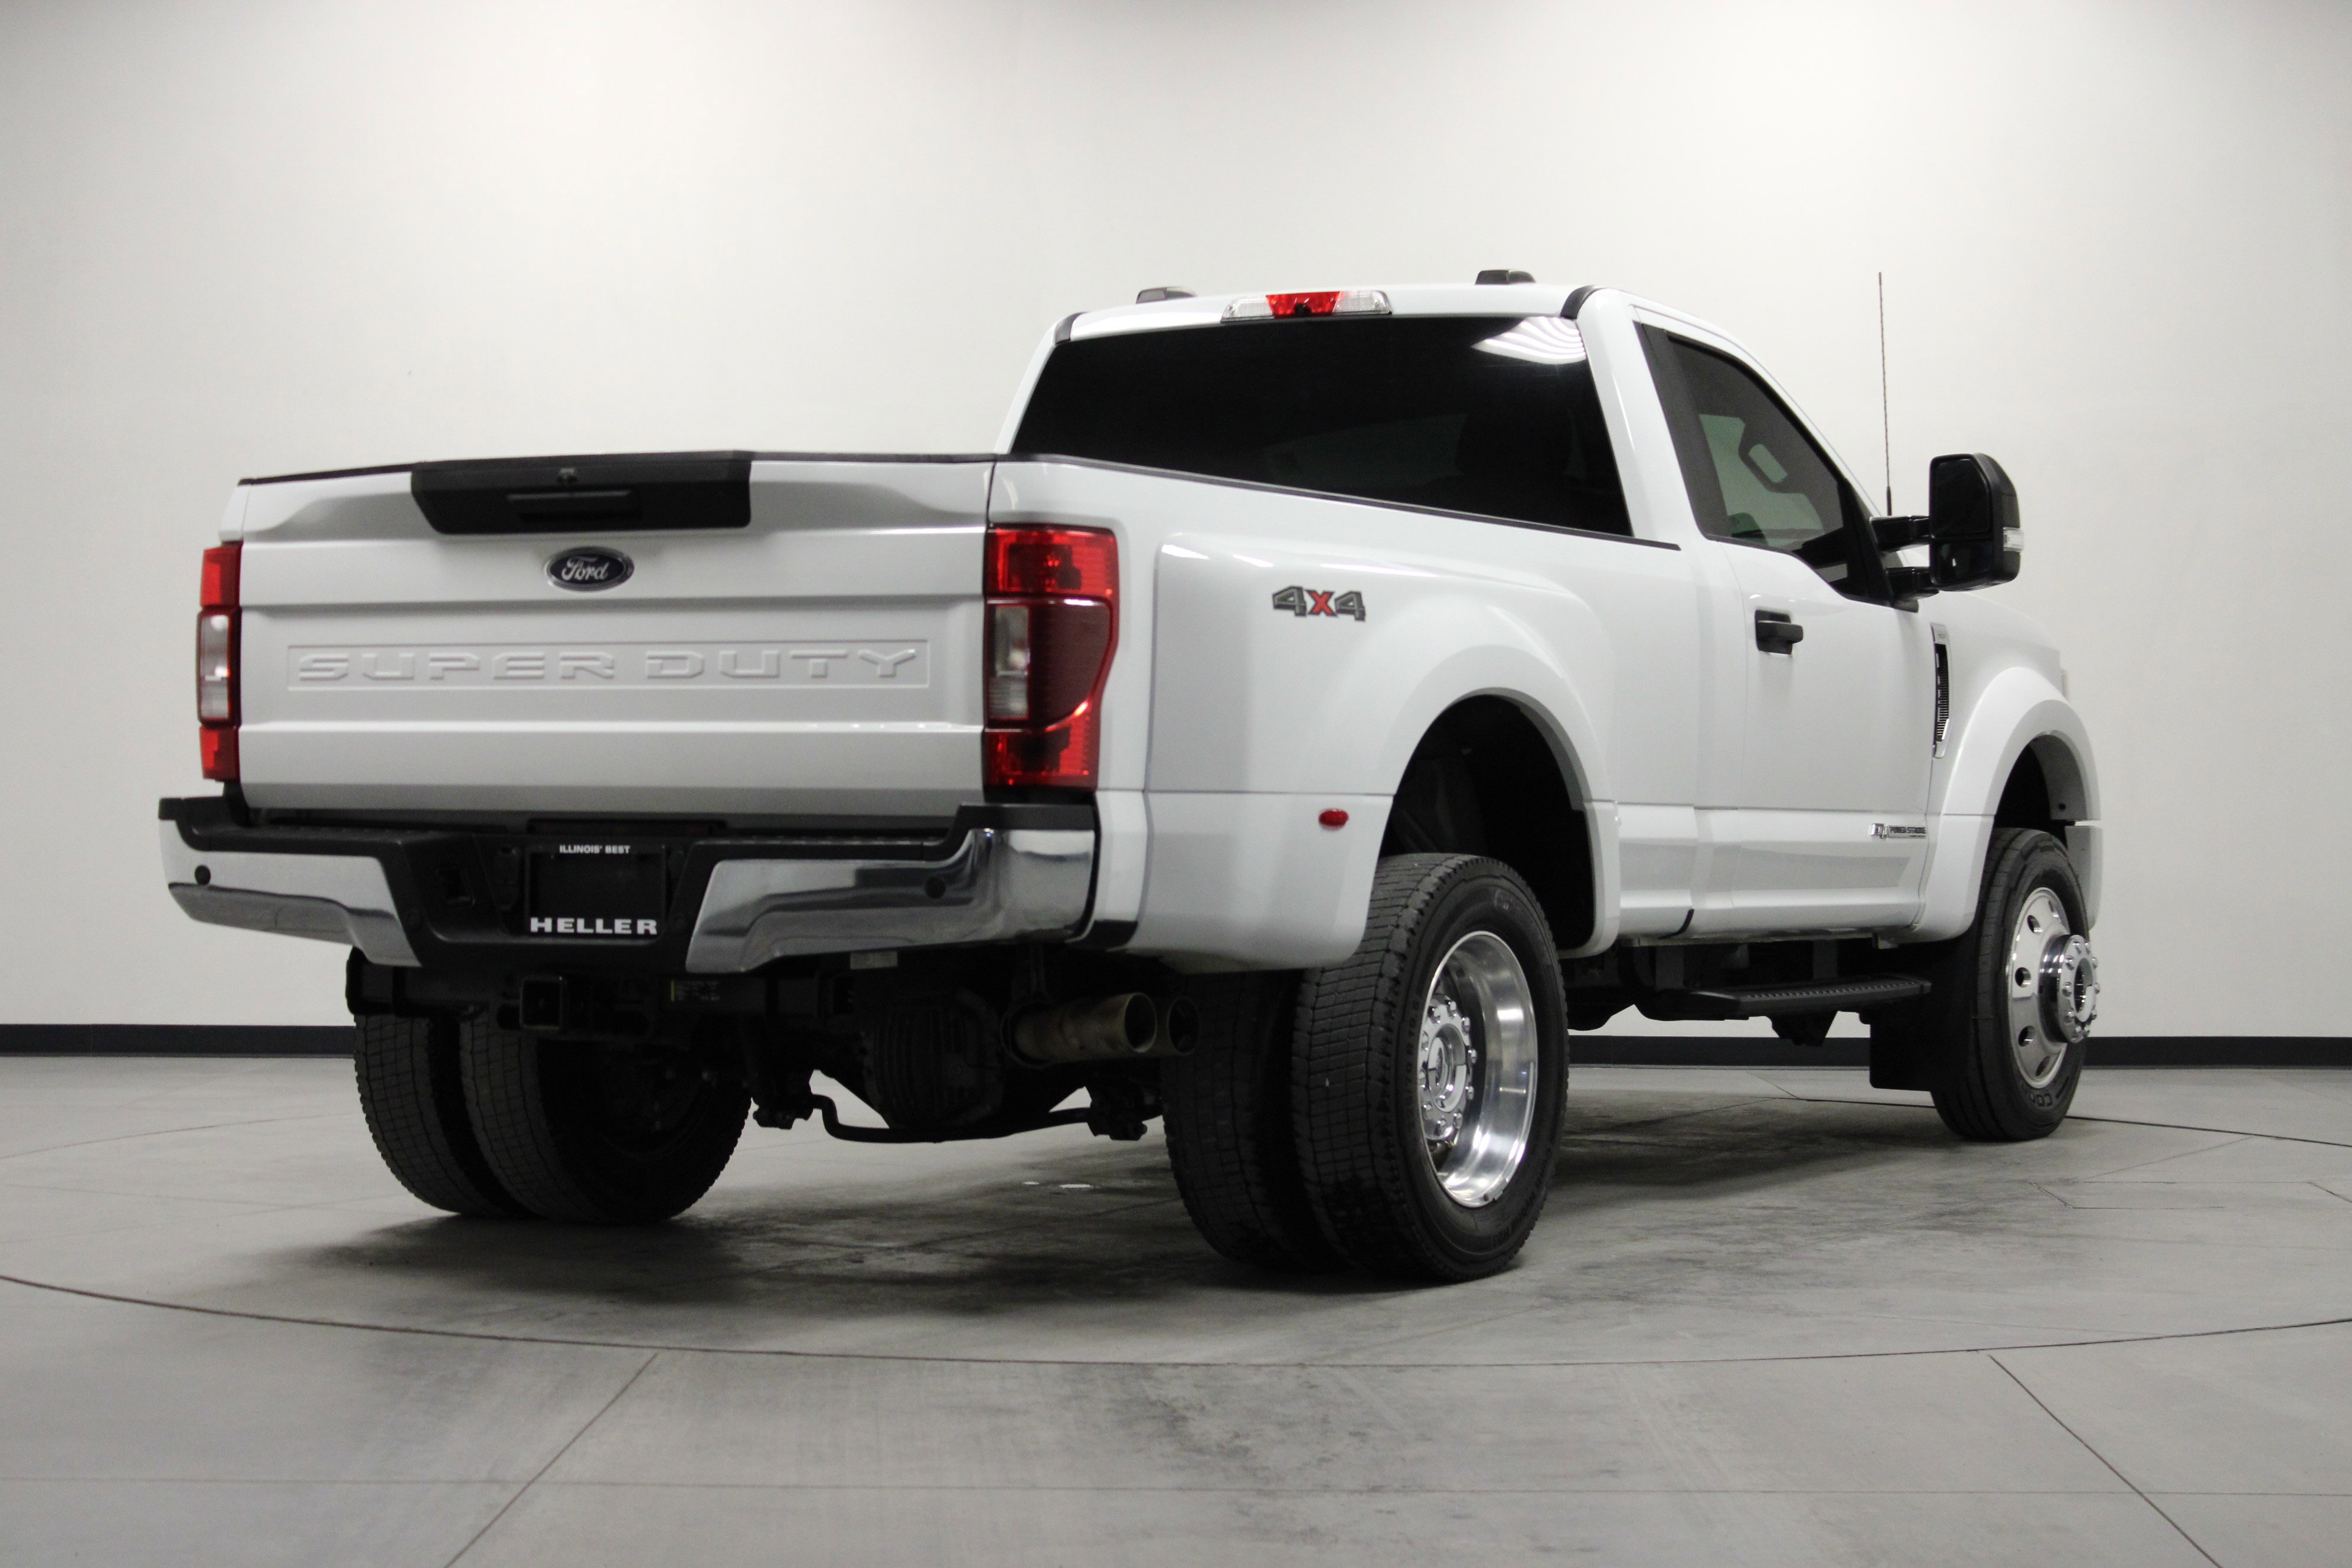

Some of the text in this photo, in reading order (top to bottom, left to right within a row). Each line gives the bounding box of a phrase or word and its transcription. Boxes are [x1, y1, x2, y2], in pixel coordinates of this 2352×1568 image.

[562, 556, 609, 581] Ford
[299, 649, 917, 681] SUPER DUTY
[605, 845, 631, 854] BEST
[530, 917, 658, 935] HELLER
